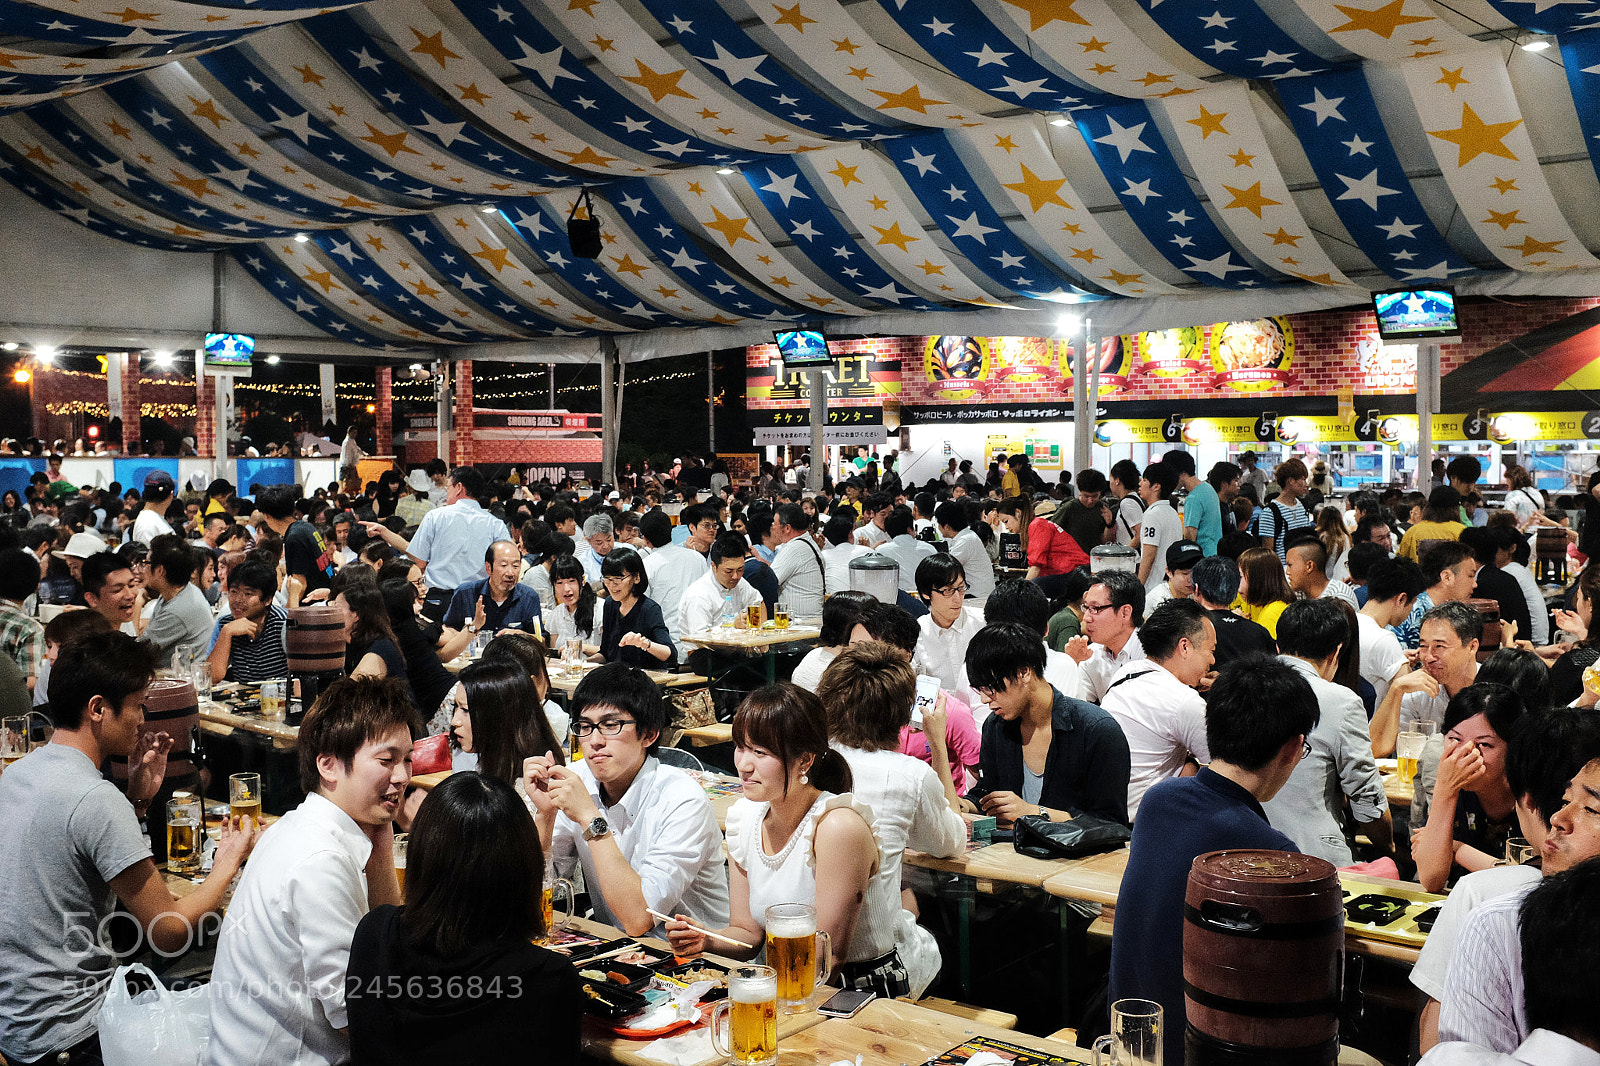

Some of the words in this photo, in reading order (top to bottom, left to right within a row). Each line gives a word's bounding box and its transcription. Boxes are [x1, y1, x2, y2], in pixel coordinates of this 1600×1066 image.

[1365, 375, 1414, 387] LION
[800, 388, 843, 398] COTER
[507, 416, 537, 426] SMOKING
[773, 411, 874, 423] チケッウンター
[1167, 423, 1176, 437] 6
[1260, 422, 1270, 436] 5
[1360, 420, 1371, 436] 4
[1469, 419, 1481, 435] 3
[1588, 417, 1600, 433] 2
[511, 467, 566, 486] OKING
[1144, 526, 1156, 538] 28
